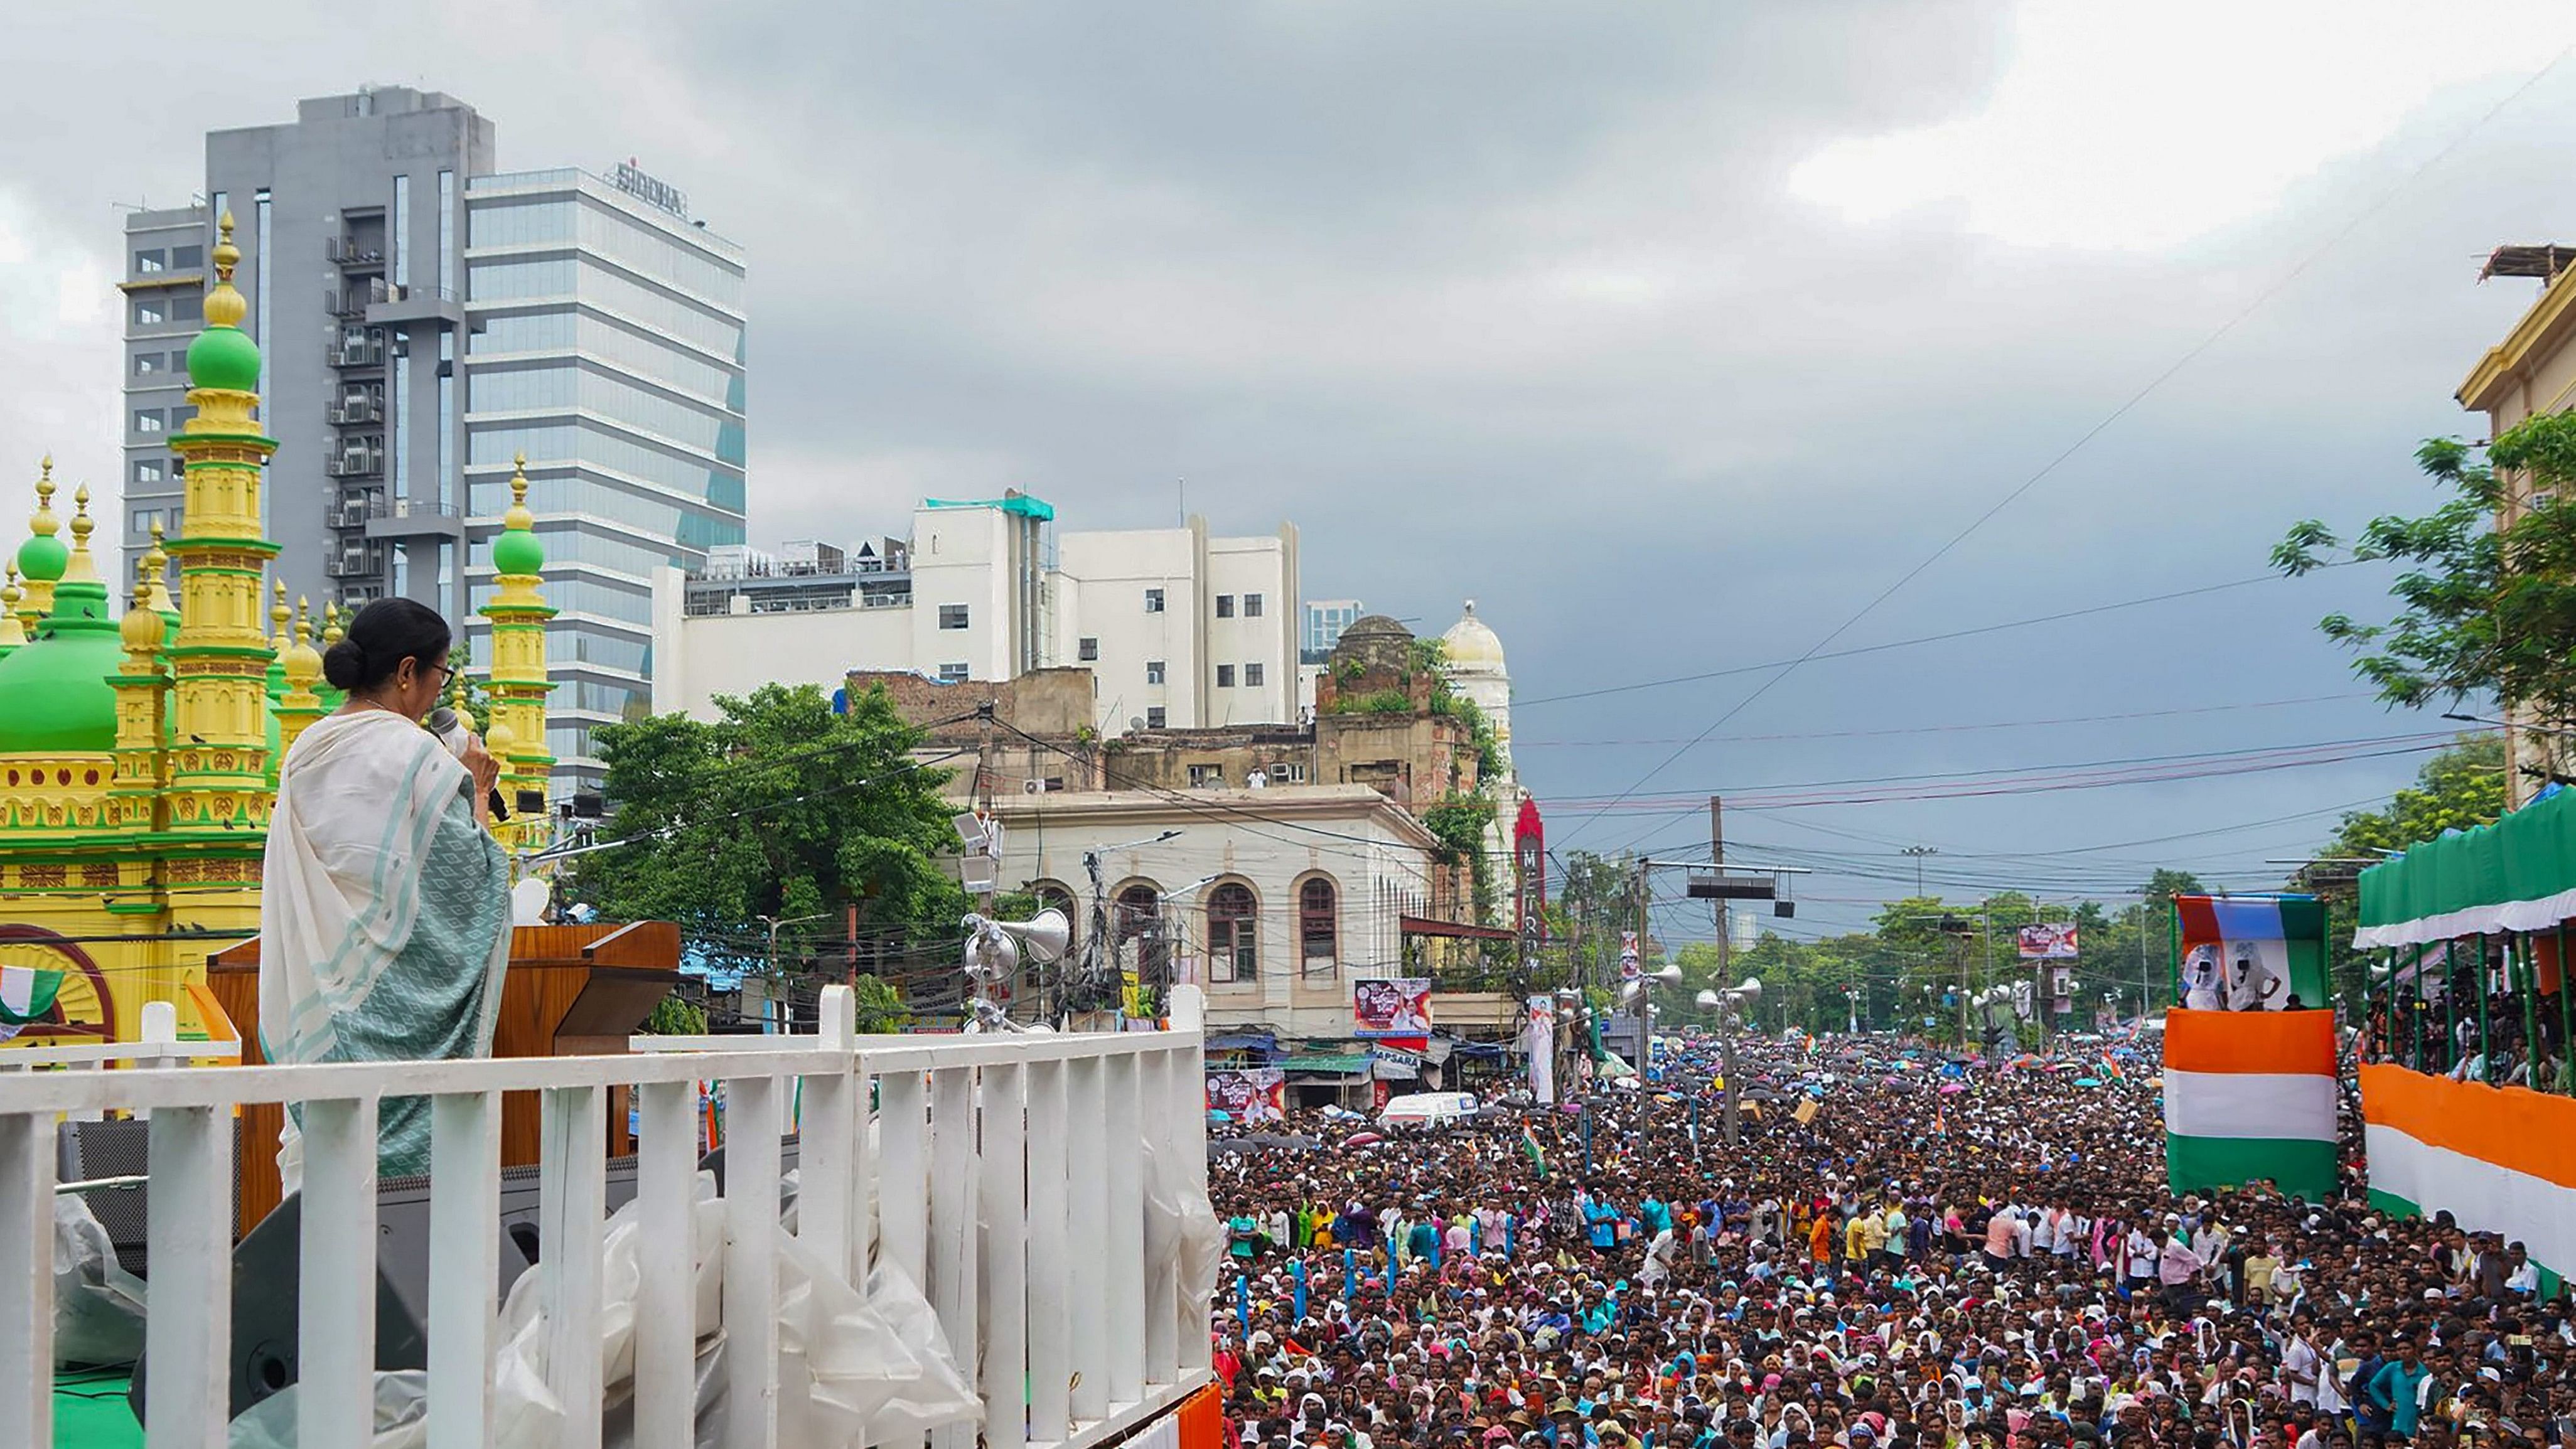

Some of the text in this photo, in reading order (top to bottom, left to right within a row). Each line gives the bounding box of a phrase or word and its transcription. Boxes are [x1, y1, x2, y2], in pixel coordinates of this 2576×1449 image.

[618, 157, 681, 213] SIDDHA
[1523, 849, 1537, 953] METRO
[1377, 1051, 1417, 1066] APSARA
